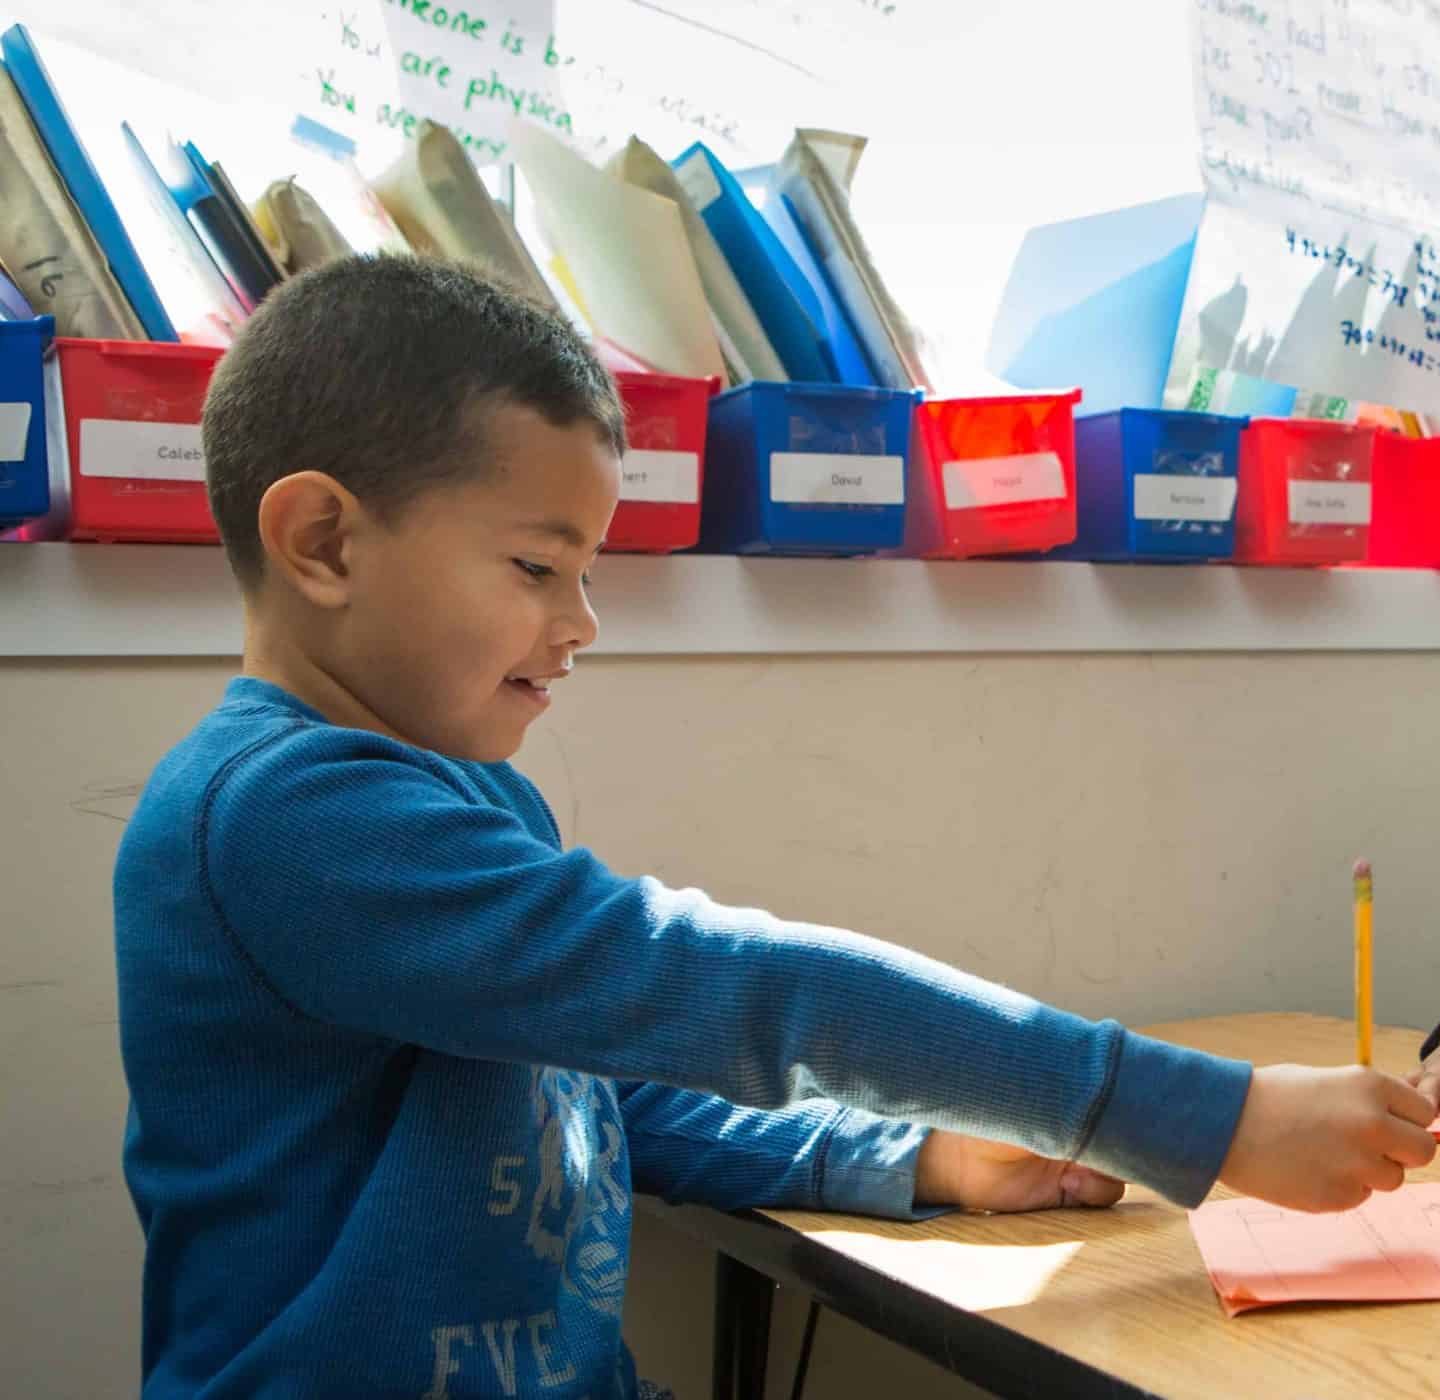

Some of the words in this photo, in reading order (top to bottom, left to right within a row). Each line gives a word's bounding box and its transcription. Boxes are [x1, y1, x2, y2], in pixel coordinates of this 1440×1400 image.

[500, 17, 526, 56] is
[400, 49, 453, 88] are
[156, 446, 203, 461] Caleb
[831, 472, 863, 488] David
[486, 1154, 527, 1217] 5
